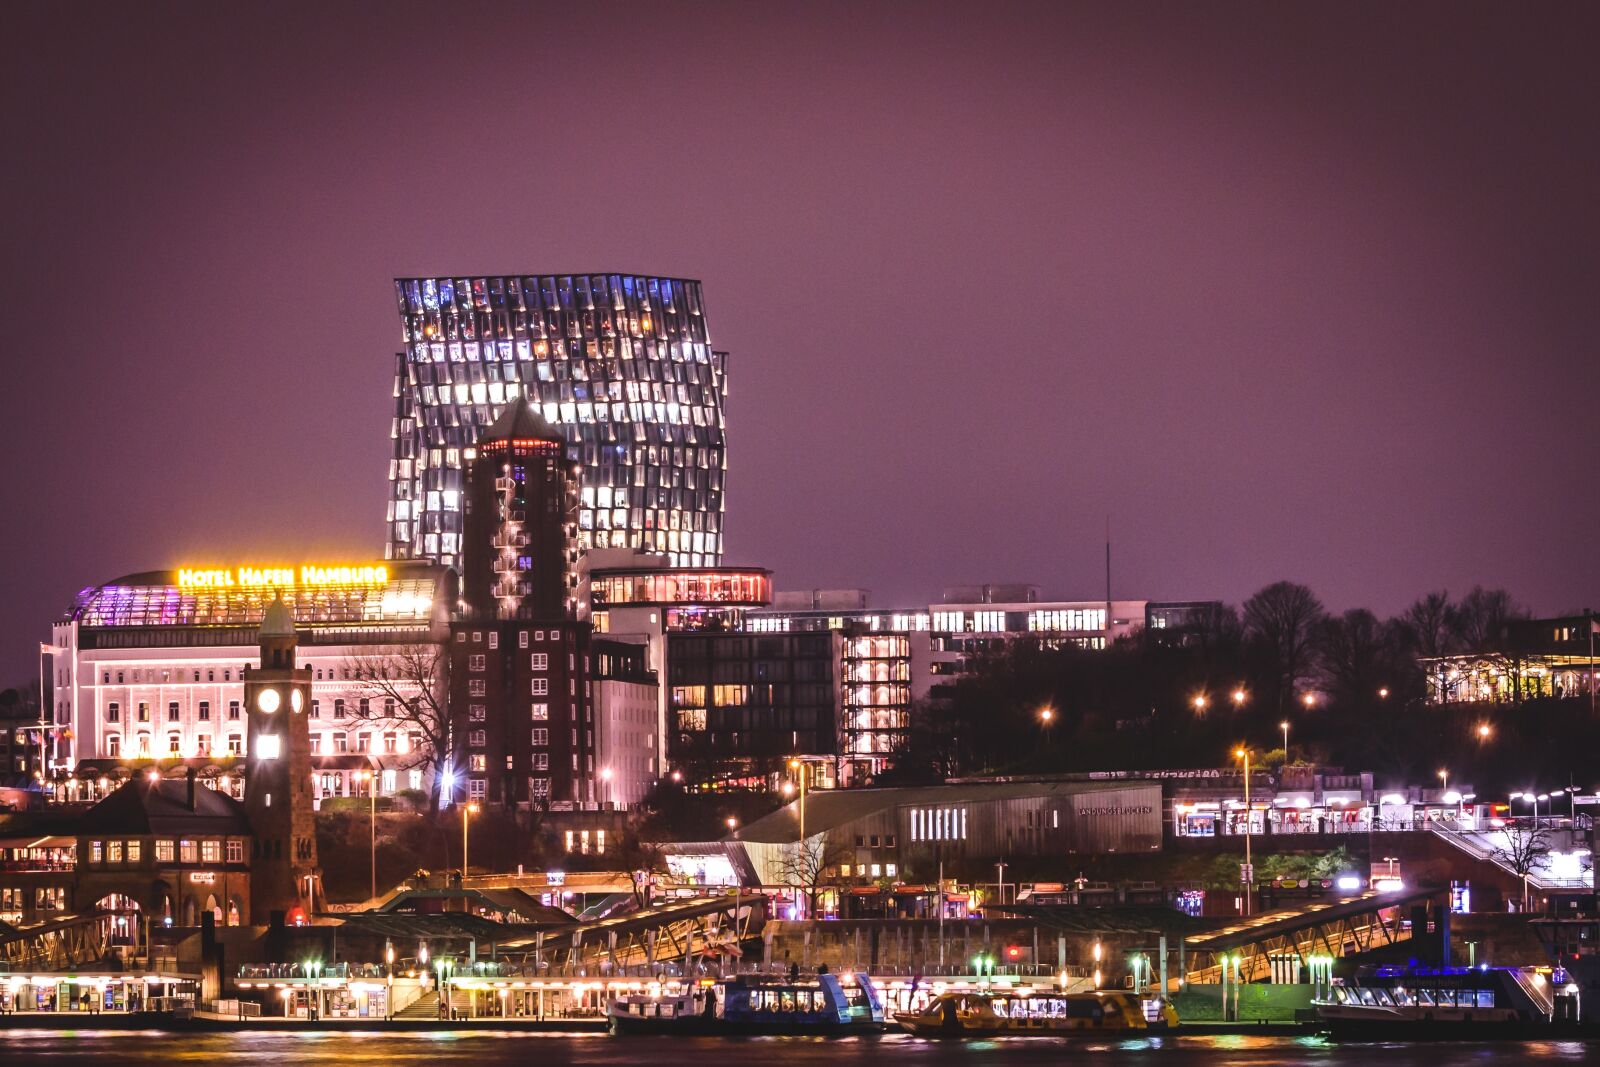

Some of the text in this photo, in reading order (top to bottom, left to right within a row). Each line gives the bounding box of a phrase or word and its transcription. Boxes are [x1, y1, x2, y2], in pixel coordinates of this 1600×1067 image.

[178, 566, 388, 586] HOTEL HAFEN HAMBURG
